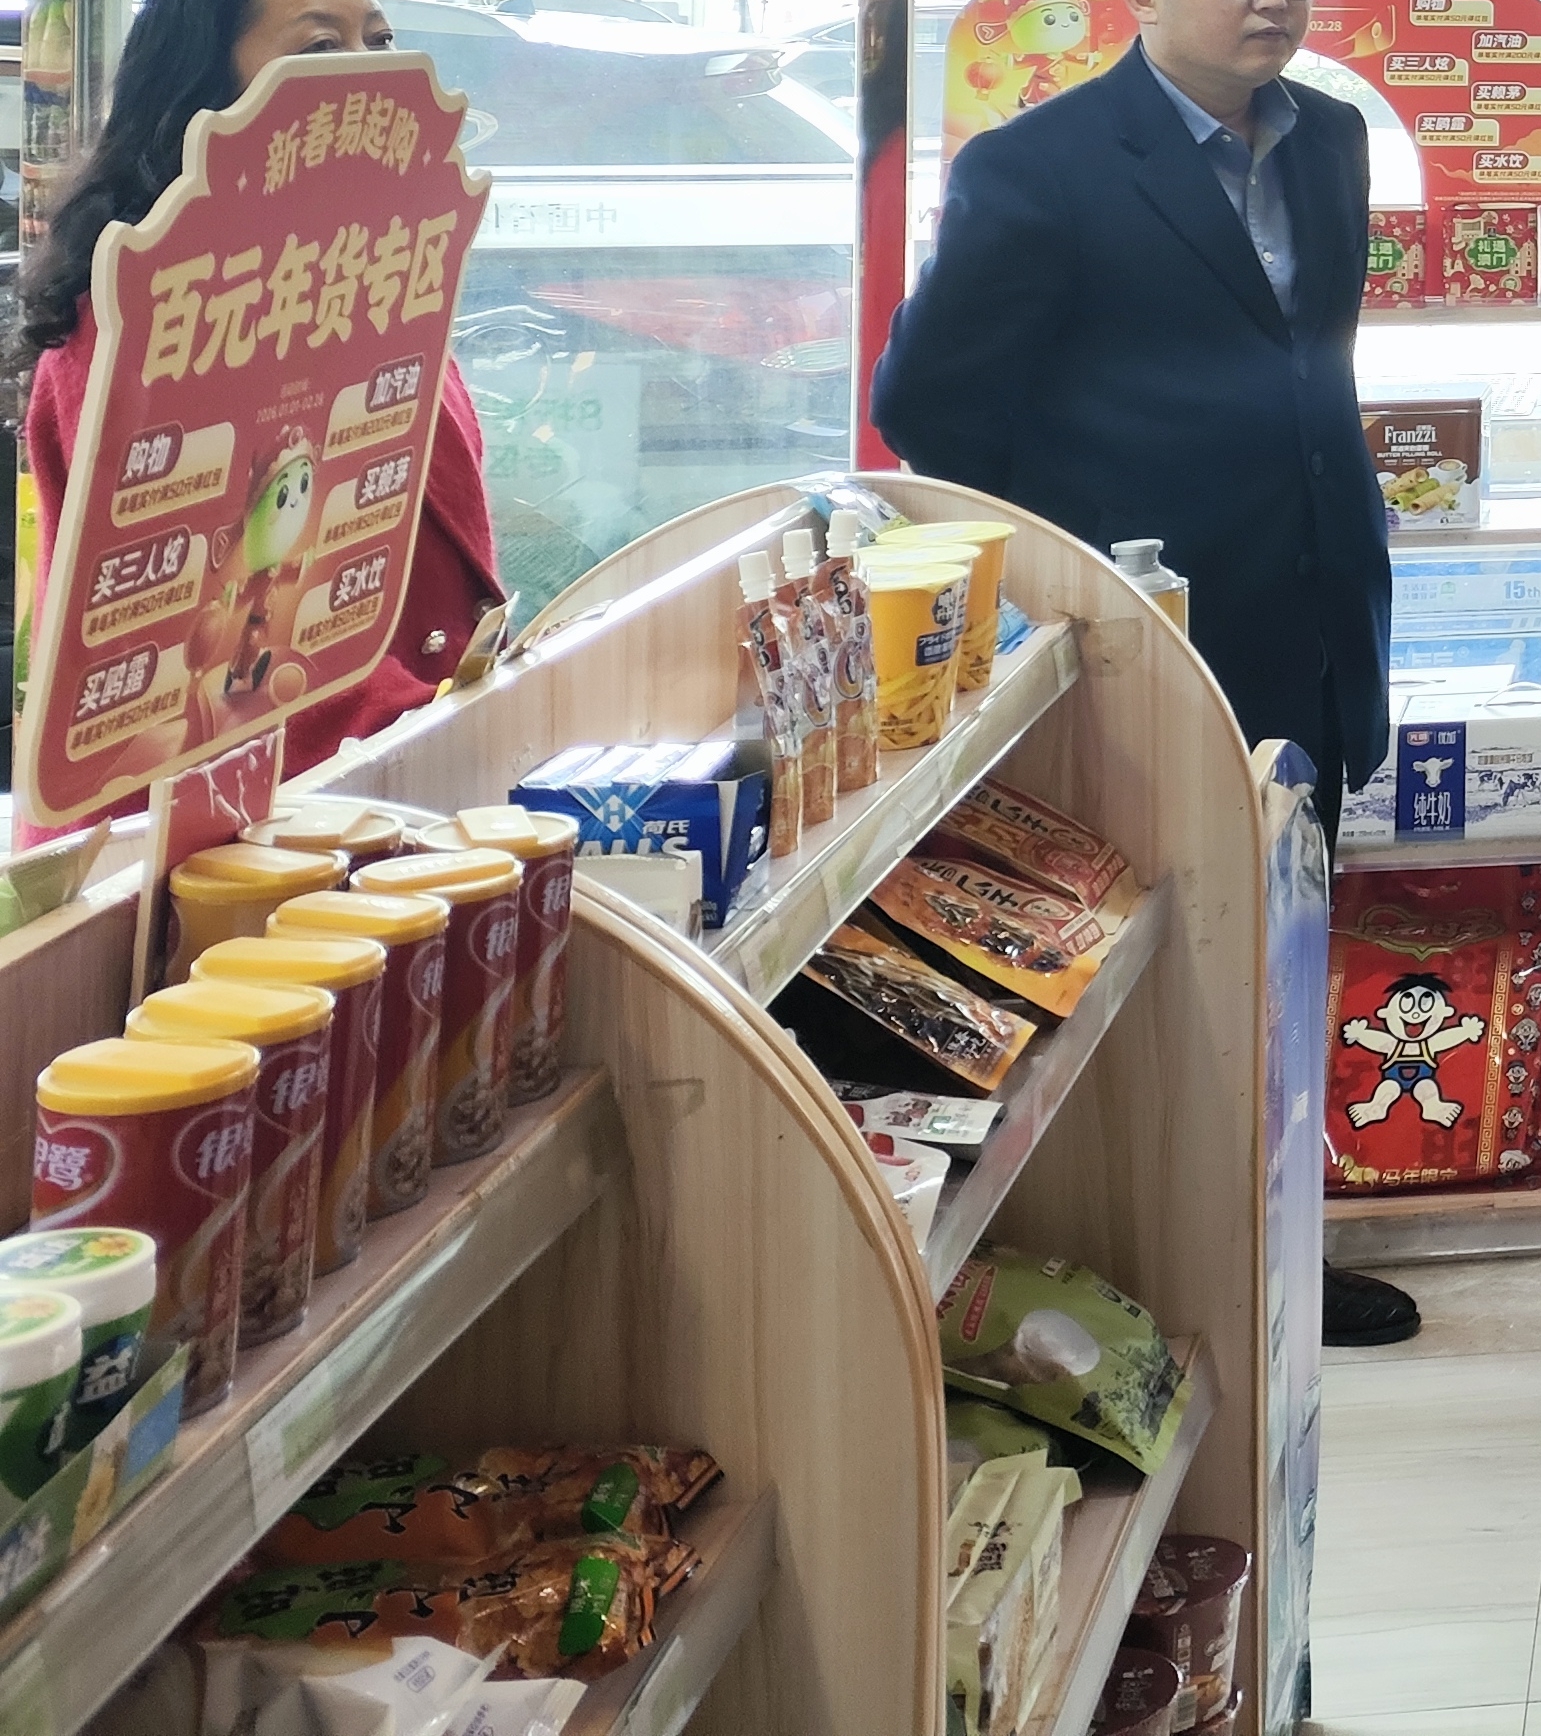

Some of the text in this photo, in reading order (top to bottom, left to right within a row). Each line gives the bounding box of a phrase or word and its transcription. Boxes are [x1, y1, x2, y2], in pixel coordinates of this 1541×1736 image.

[1477, 34, 1523, 48] 加汽油
[1389, 57, 1450, 71] 买三人炫
[1476, 86, 1522, 100] 买赖茅
[263, 91, 420, 196] 新春易起购
[1479, 154, 1524, 168] 买水饮
[141, 210, 460, 391] 百元年货专区
[370, 362, 421, 407] 加汽油
[1384, 425, 1437, 444] Franzzi
[122, 433, 173, 483] 购物
[91, 533, 185, 604] 买三人炫
[334, 554, 386, 607] 买水饮
[1413, 792, 1451, 826] 纯牛奶
[642, 820, 690, 835] 荷氏
[196, 1112, 254, 1178] 银
[1381, 1167, 1459, 1187] 马年限定
